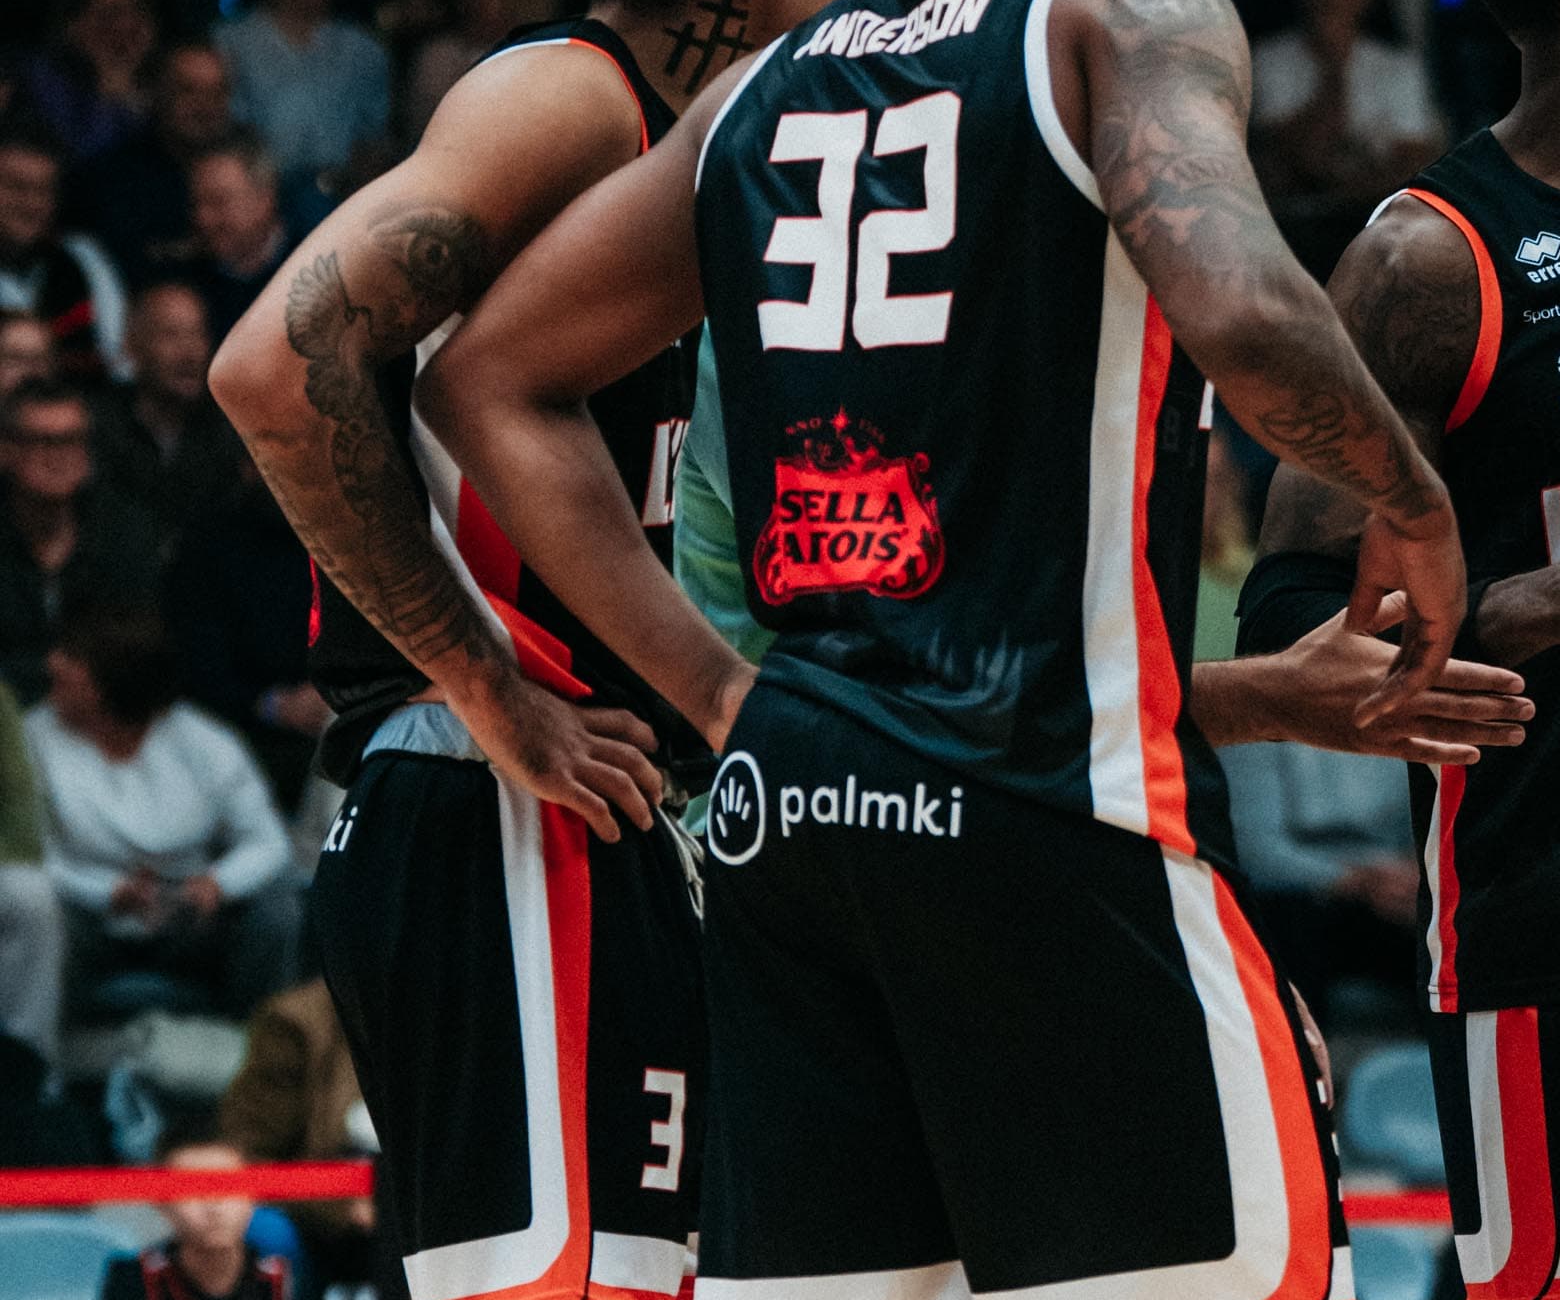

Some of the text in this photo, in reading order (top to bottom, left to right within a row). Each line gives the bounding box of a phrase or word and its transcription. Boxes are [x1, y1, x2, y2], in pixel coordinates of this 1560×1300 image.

[757, 91, 962, 351] 32
[780, 774, 964, 839] palmki
[640, 1067, 686, 1192] 3
